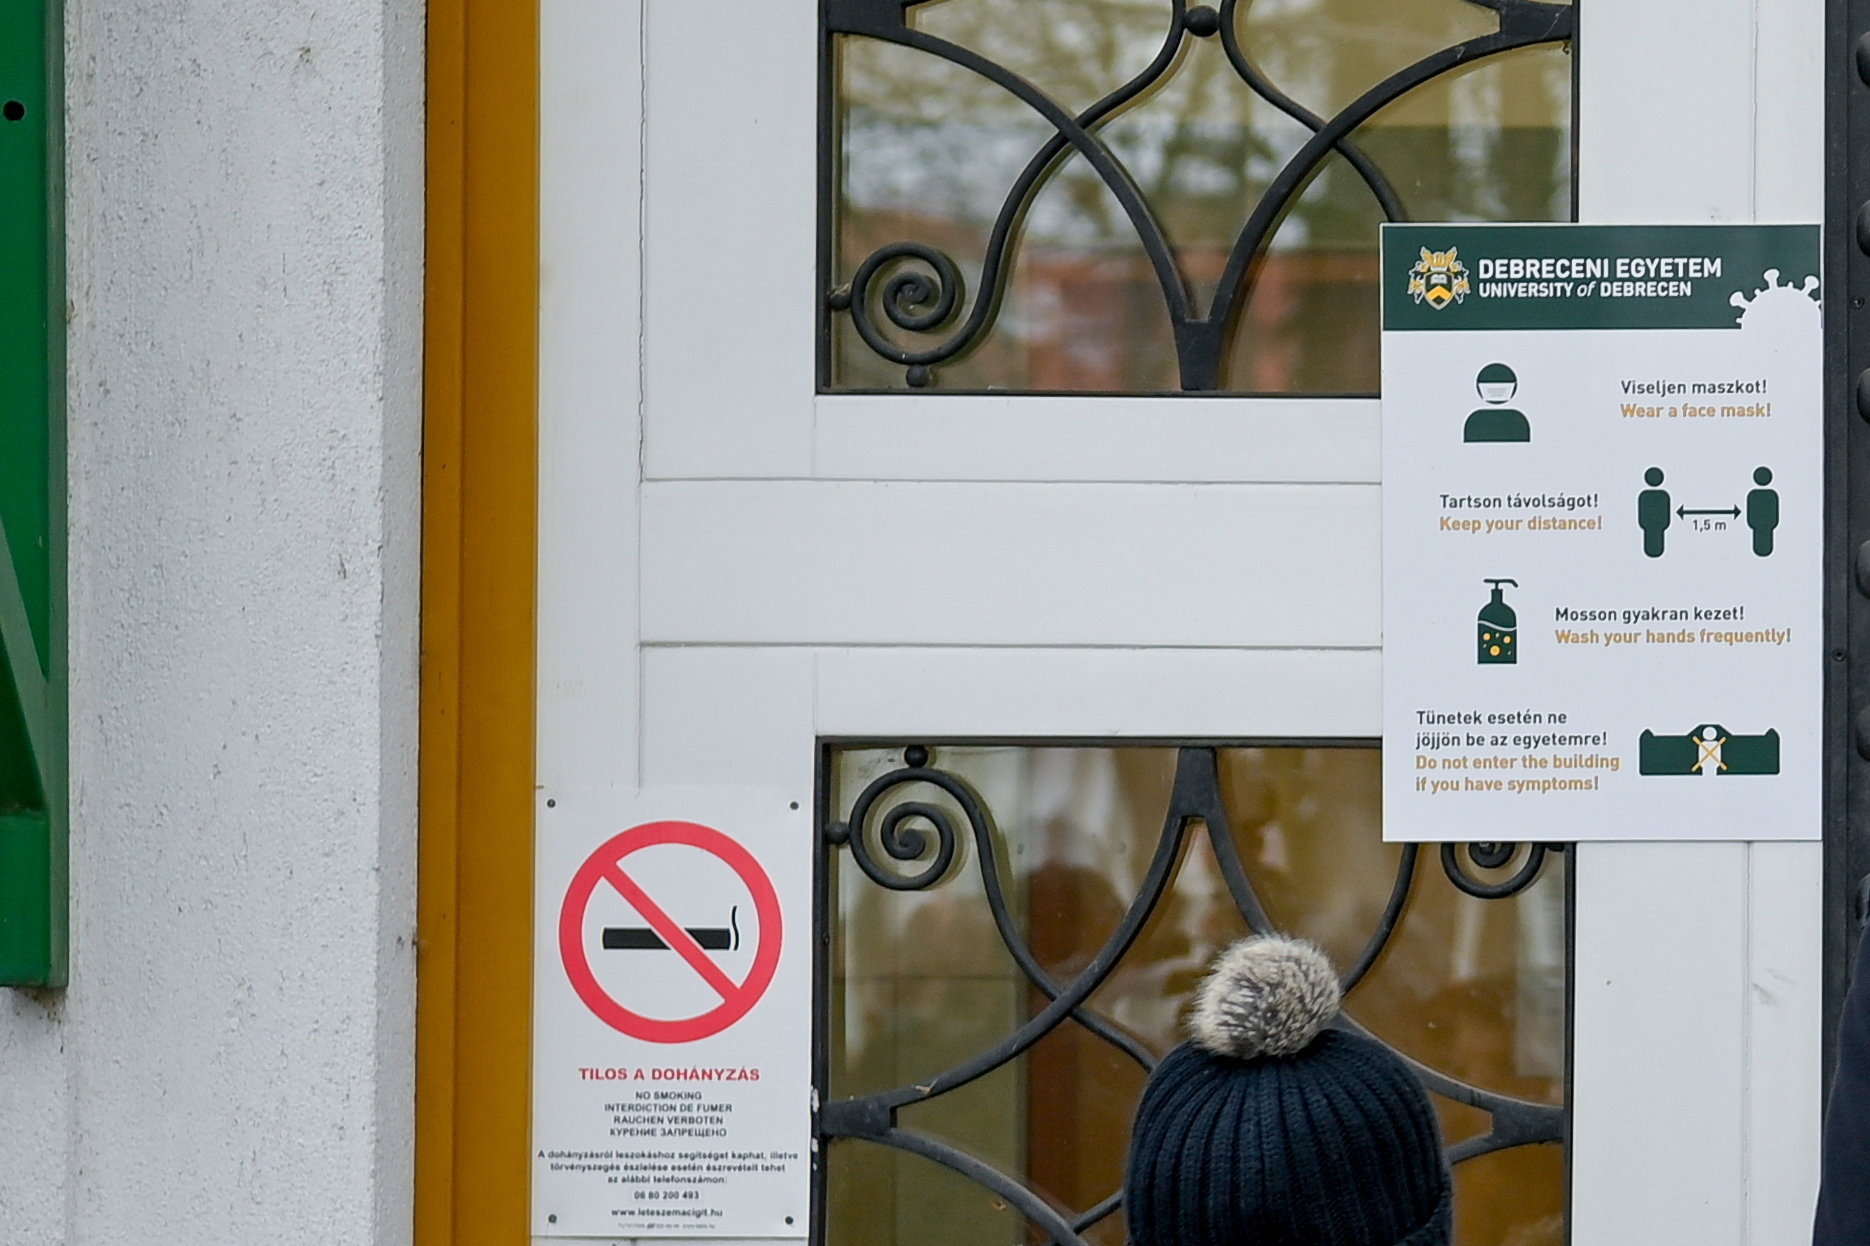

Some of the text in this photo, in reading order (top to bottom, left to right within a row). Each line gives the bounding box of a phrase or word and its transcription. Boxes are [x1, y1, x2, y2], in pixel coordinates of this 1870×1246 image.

[1479, 258, 1721, 279] DEBRECENI EGYETEM
[1479, 281, 1691, 297] UNIVERSITY of DEBRECEN
[1621, 380, 1766, 397] Viseljen maszkot!
[1620, 403, 1770, 417] Wear a face mask!
[1440, 493, 1597, 511] Tartson távolságot!
[1440, 516, 1601, 534] Keep your distance!
[1693, 519, 1726, 532] 1,5 m
[1556, 606, 1743, 624] Mosson gyakran kezet!
[1555, 628, 1790, 647] Wash your hands frequently!
[1416, 709, 1566, 724] Tünetek esetén ne
[1416, 732, 1606, 750] jöjjön be az egyetemre!
[1416, 754, 1619, 771] Do not enter the building
[1416, 776, 1598, 794] if you have symptoms!
[579, 1066, 759, 1080] TILOS A DOHÁNYZÁS
[636, 1091, 702, 1100] NO SMOKING
[605, 1103, 732, 1112] INTERDICTION DE FUMER
[614, 1116, 723, 1125] RAUCHEN VERBOTEN
[610, 1128, 726, 1138] КУРЕНИЕ ЗАПРЕЩЕНО
[538, 1150, 545, 1158] A
[548, 1151, 613, 1160] dohányzásról
[616, 1151, 675, 1159] leszokáshoz
[671, 1163, 703, 1171] esetén
[761, 1164, 785, 1172] tehet
[621, 1175, 650, 1183] alábbi
